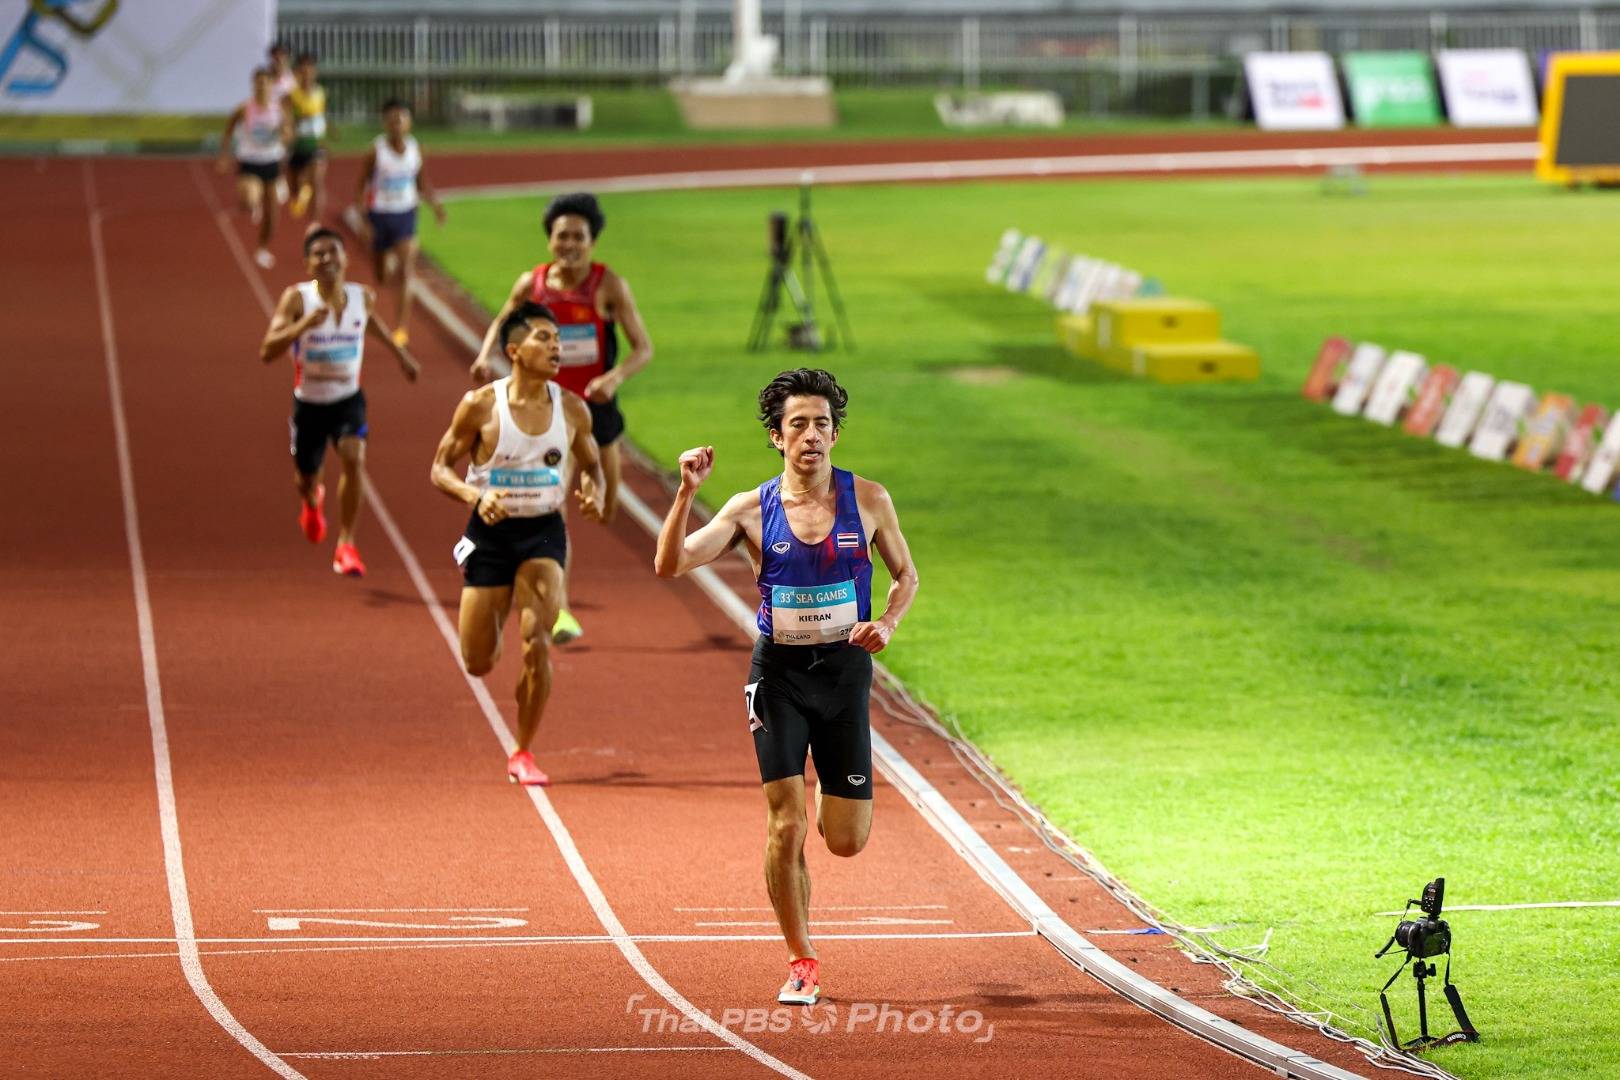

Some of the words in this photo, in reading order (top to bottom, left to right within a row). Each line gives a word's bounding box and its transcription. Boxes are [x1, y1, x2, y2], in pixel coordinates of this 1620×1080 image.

[780, 591, 795, 603] 33rd
[796, 593, 814, 604] SEA
[816, 588, 848, 602] GAMES
[798, 613, 831, 622] KIERAN
[840, 627, 853, 636] 27
[1447, 1034, 1466, 1042] Canon
